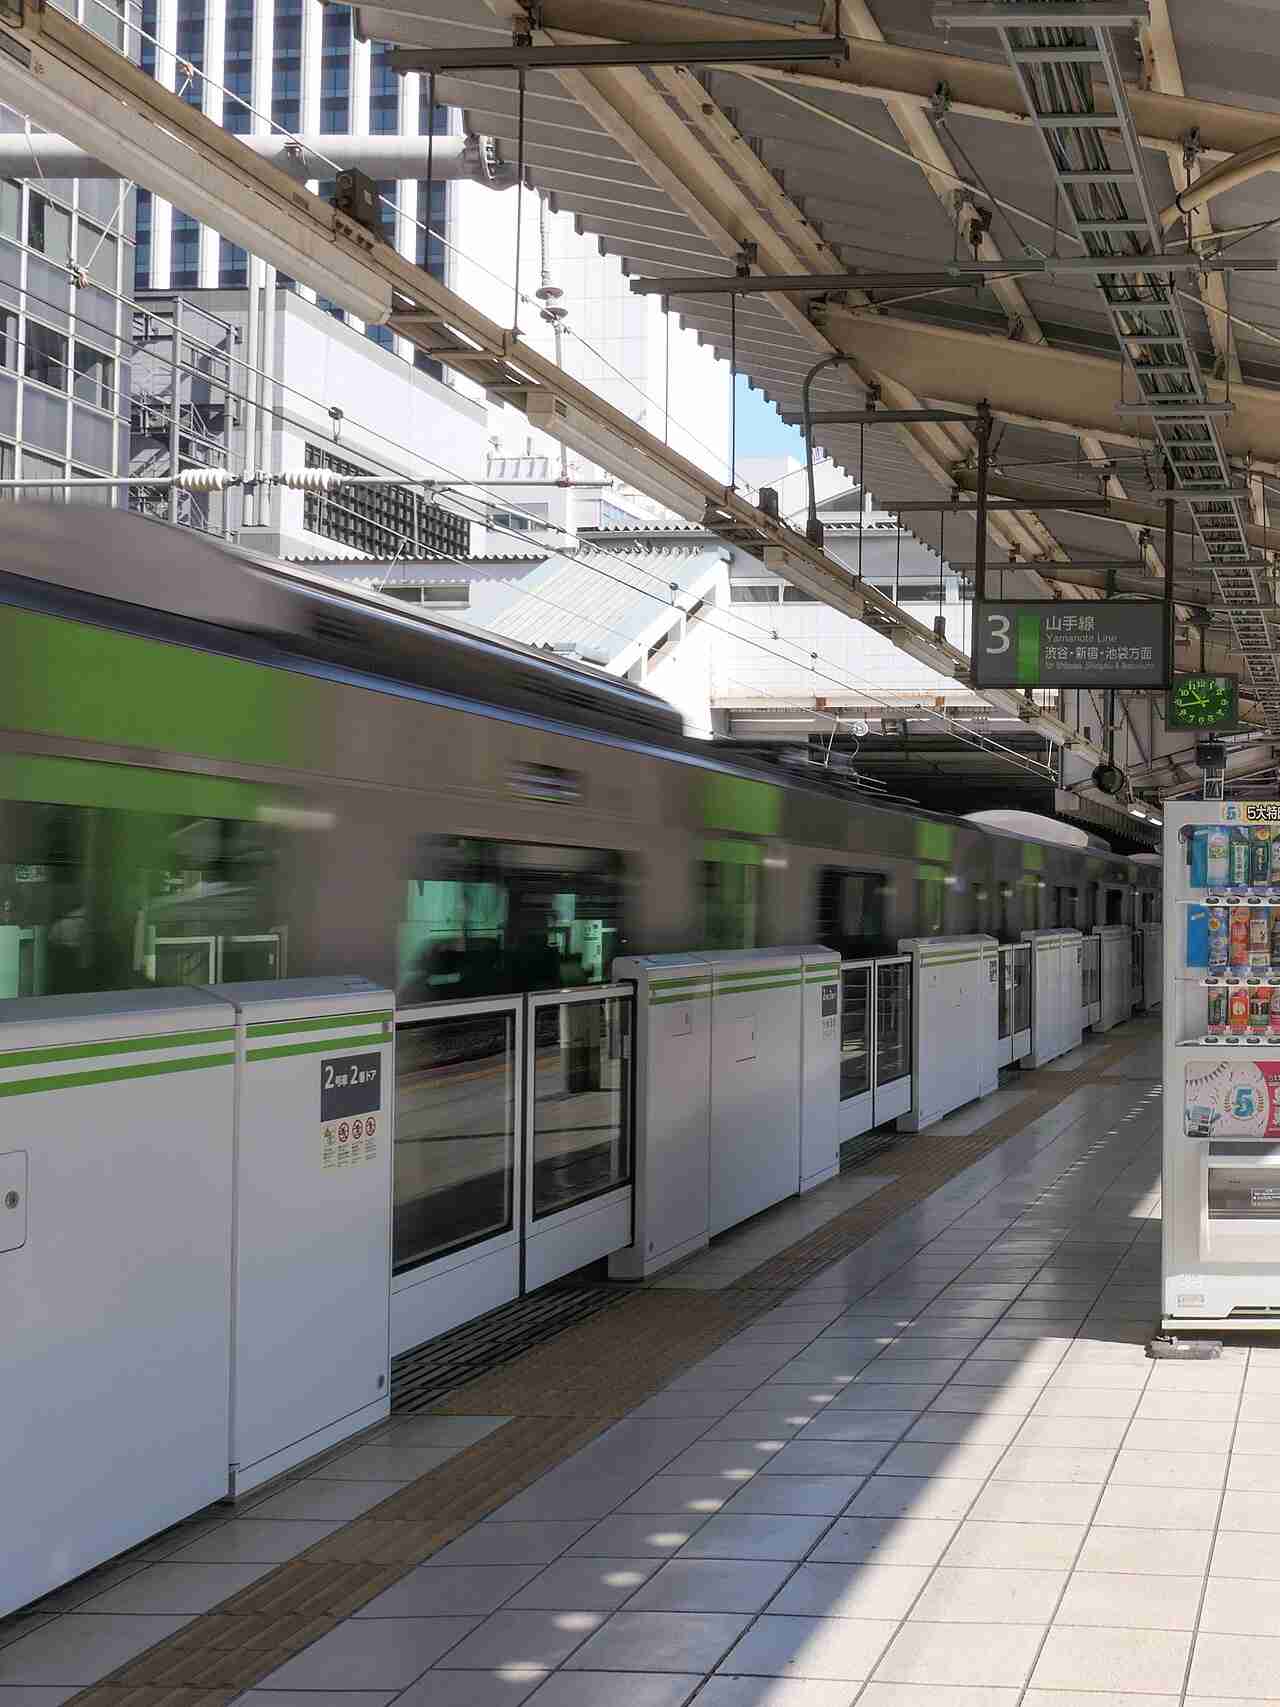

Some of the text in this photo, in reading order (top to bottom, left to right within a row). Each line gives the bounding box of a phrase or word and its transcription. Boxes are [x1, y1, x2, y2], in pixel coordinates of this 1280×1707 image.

[986, 614, 1010, 654] 3
[1046, 615, 1096, 632] 山手線
